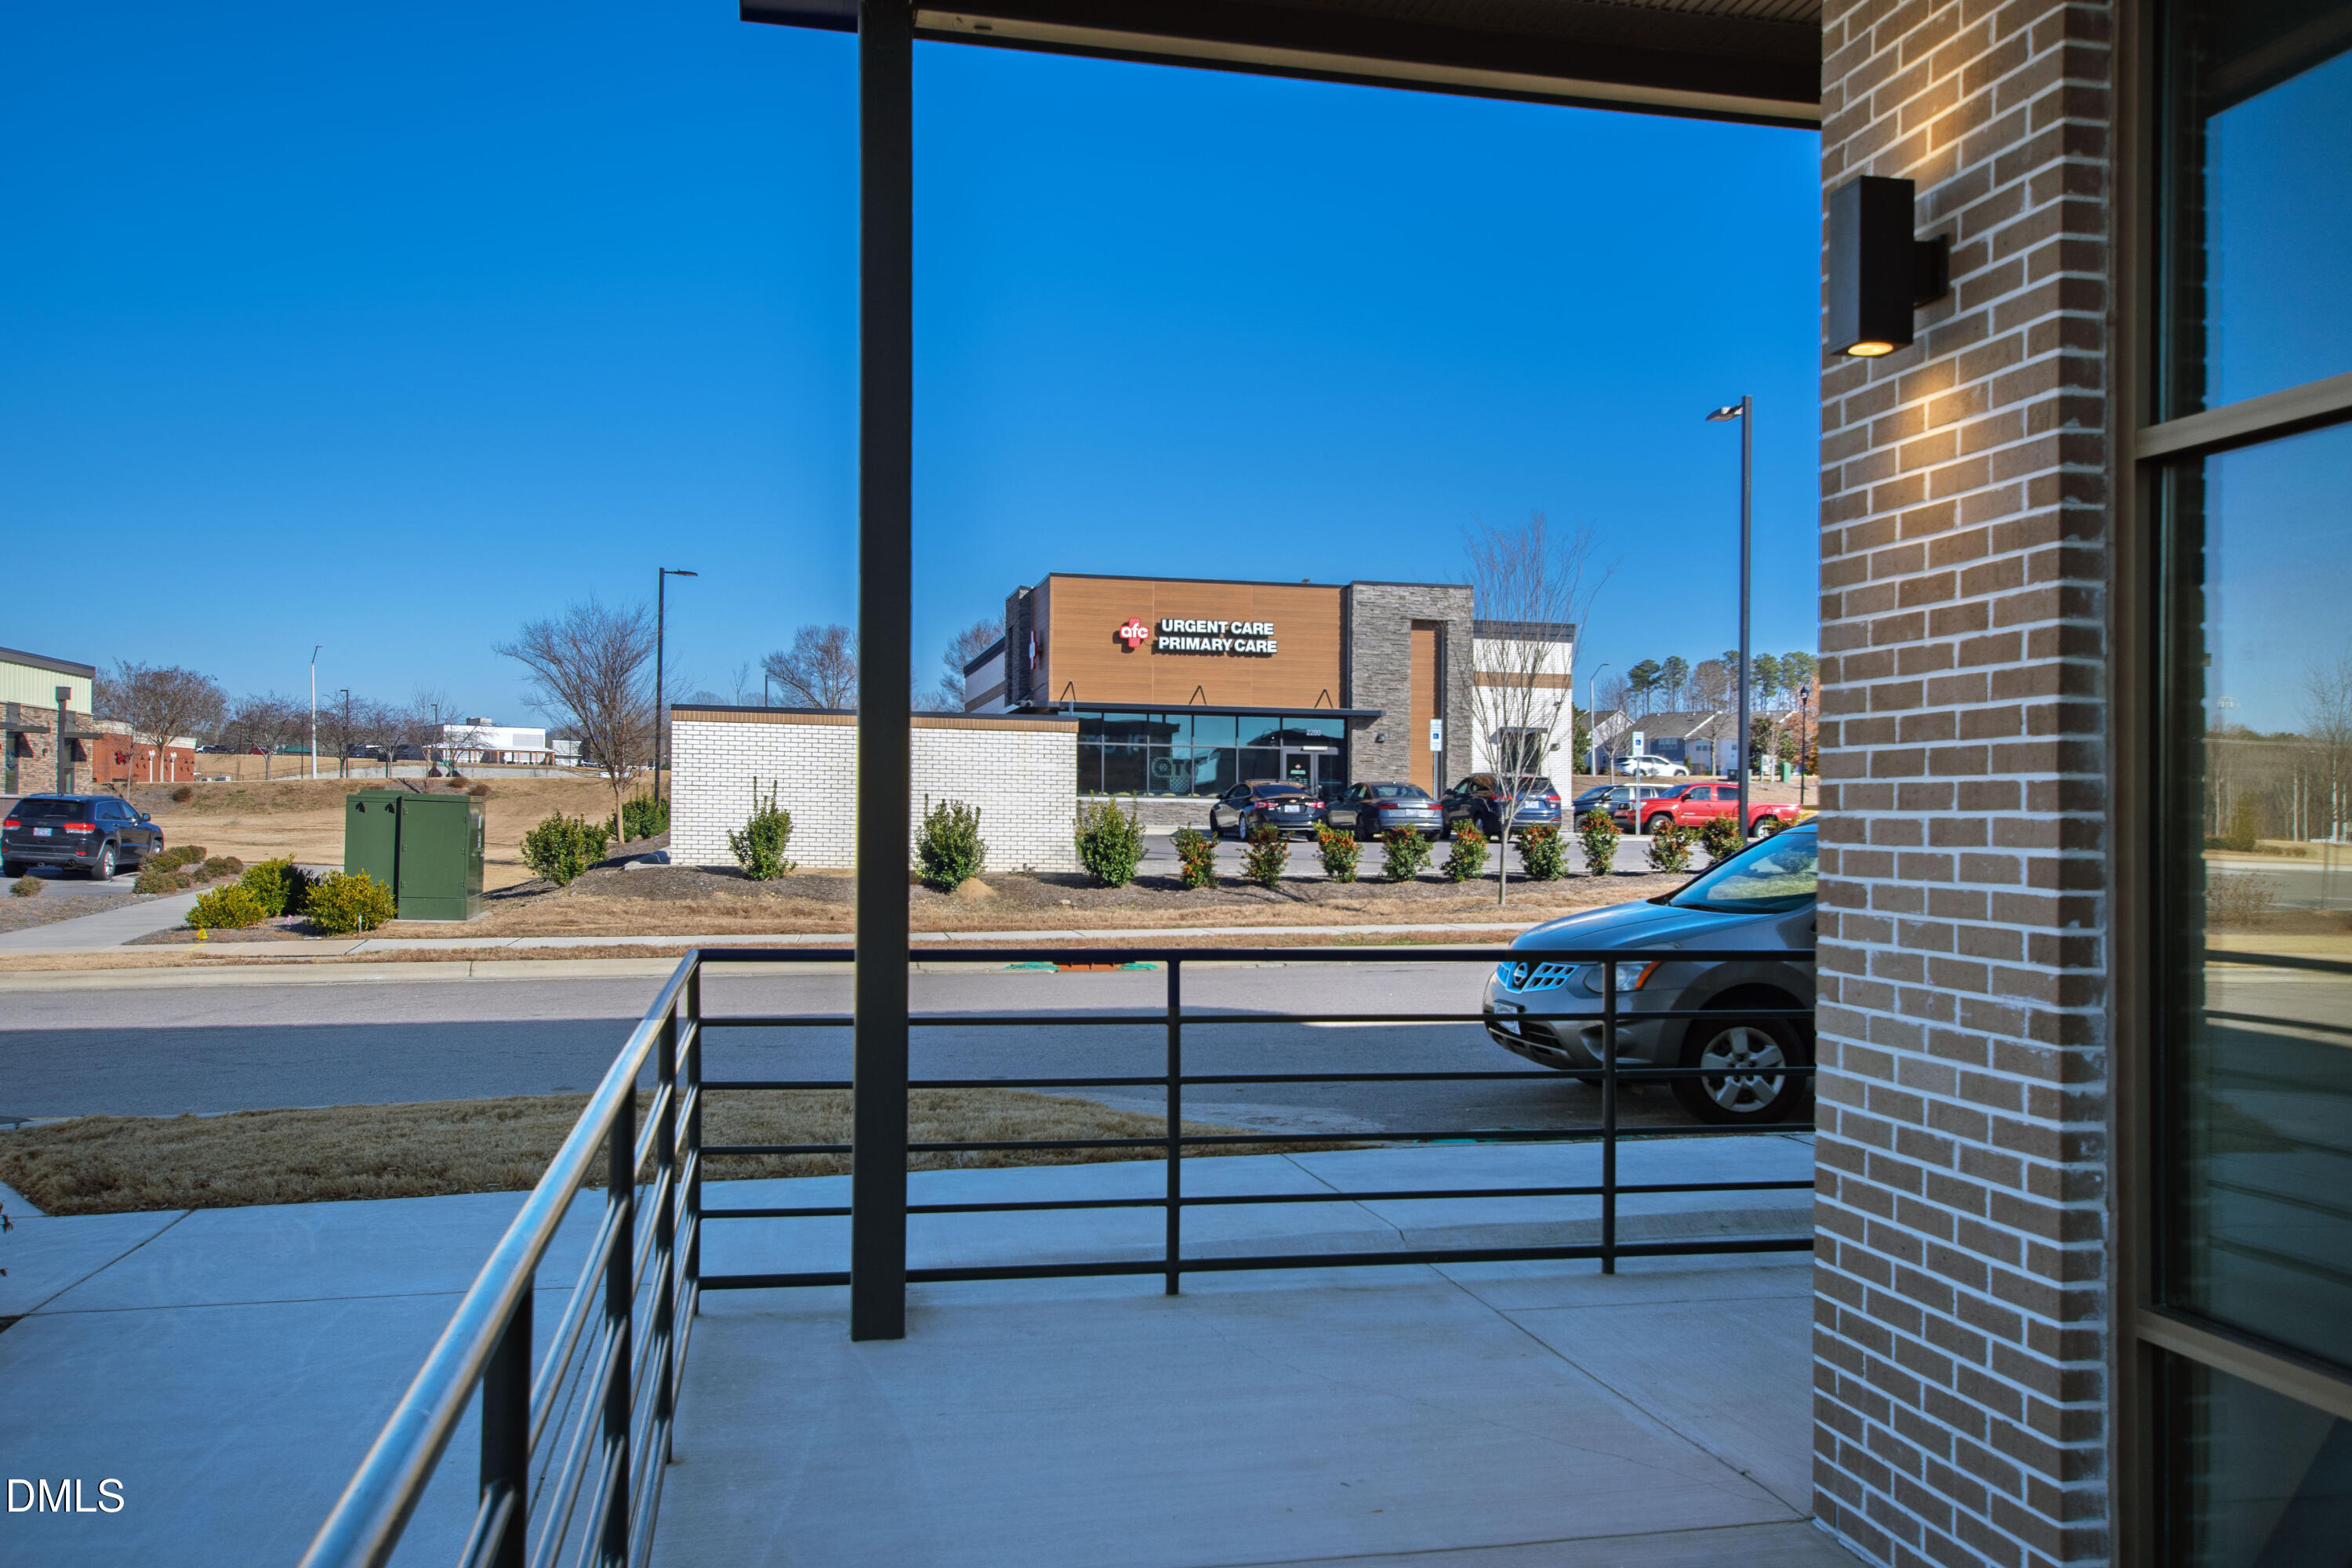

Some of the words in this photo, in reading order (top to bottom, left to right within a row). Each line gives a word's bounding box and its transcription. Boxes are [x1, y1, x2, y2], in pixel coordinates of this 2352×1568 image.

[1120, 622, 1149, 639] afc
[1162, 619, 1229, 633] URGENT
[1231, 622, 1274, 635] CARE
[1158, 637, 1232, 652] PRIMARY
[1234, 640, 1278, 653] CARE
